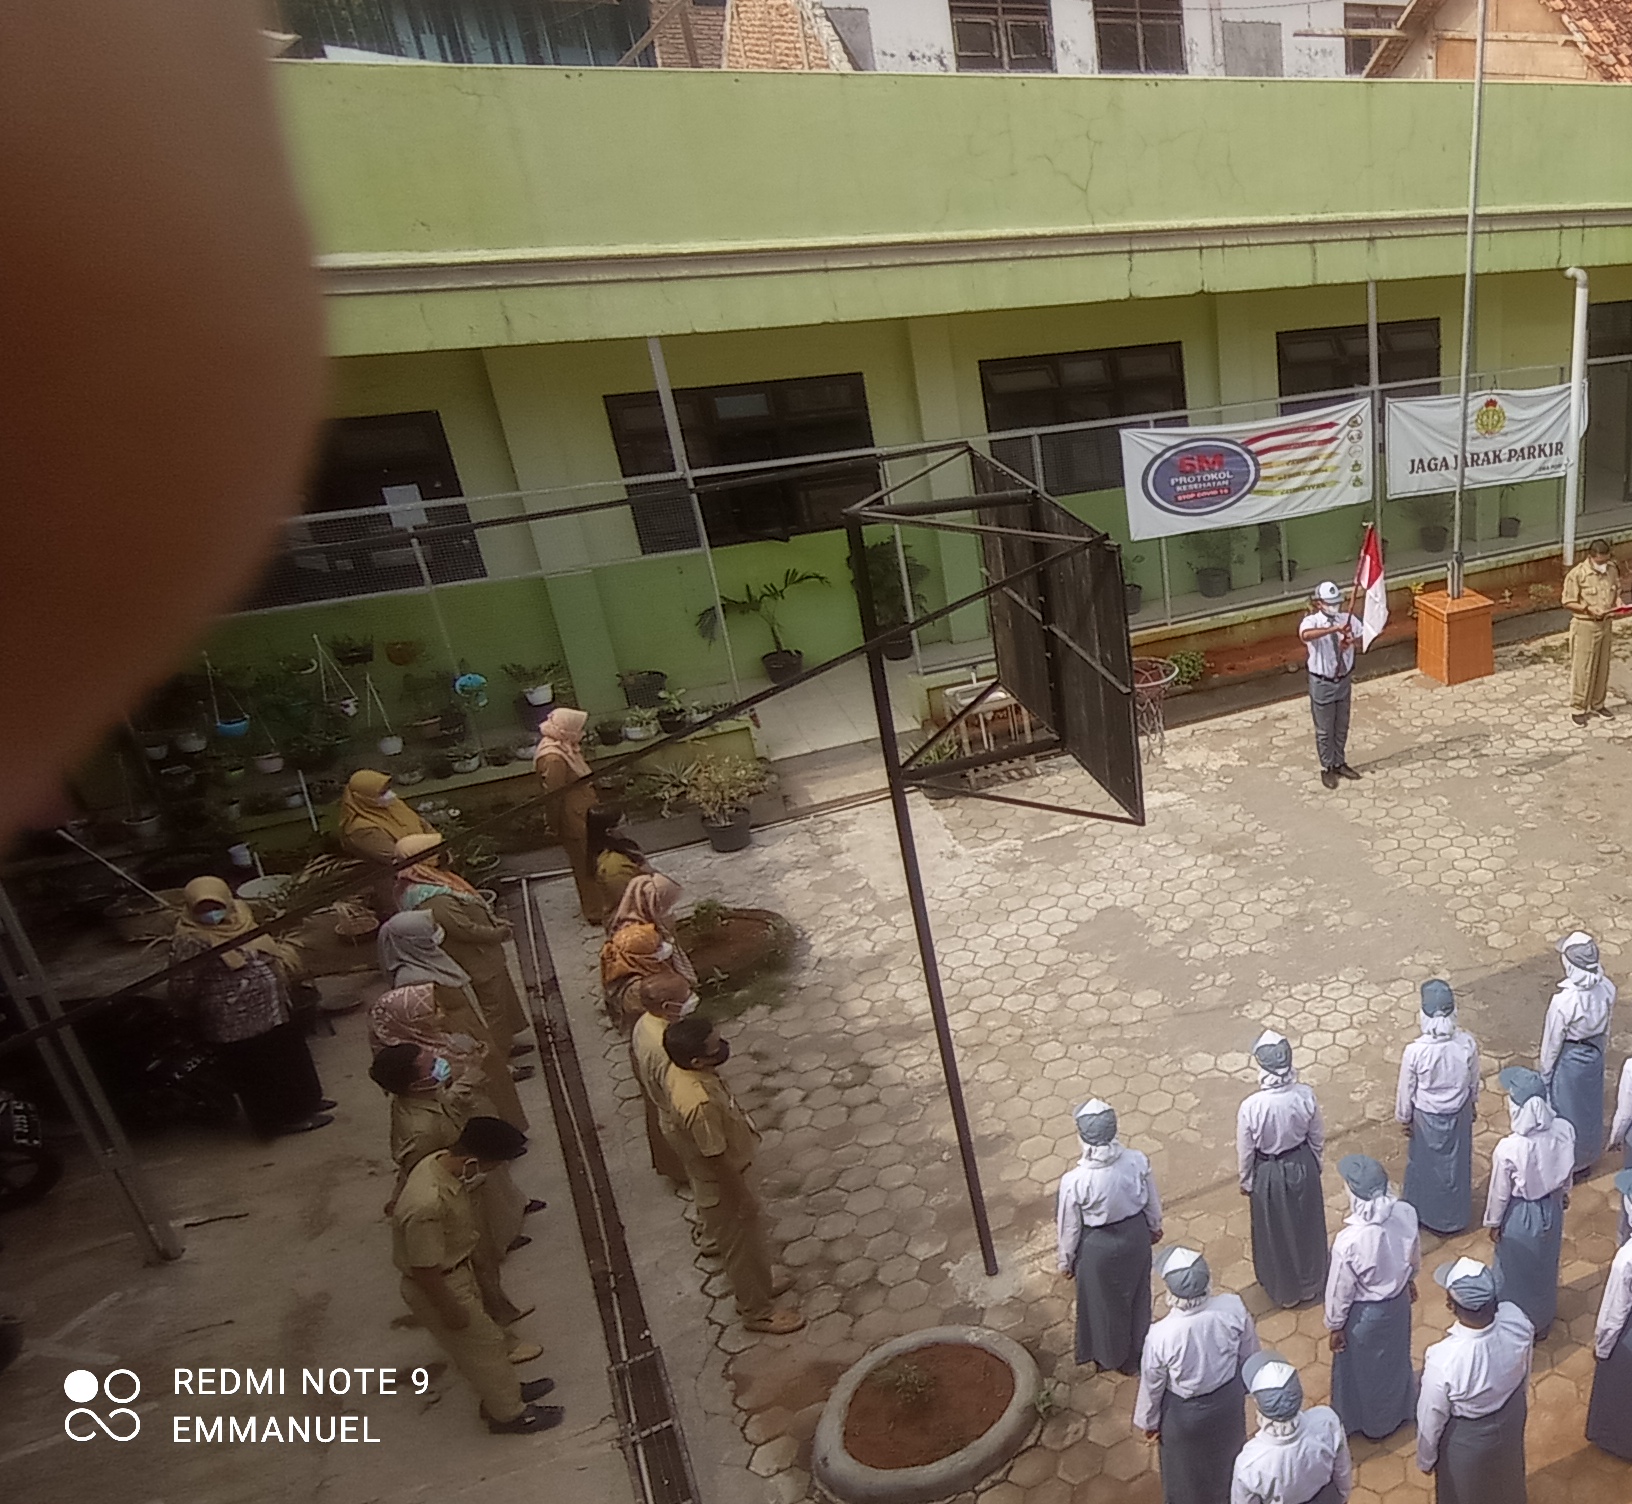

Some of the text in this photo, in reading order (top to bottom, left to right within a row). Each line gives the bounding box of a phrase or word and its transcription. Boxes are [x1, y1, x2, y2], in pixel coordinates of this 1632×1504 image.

[1408, 456, 1450, 475] JAGA
[1507, 441, 1564, 461] PARKIR
[1170, 470, 1233, 486] PROTOKOL
[1175, 479, 1229, 492] KESEHATAN
